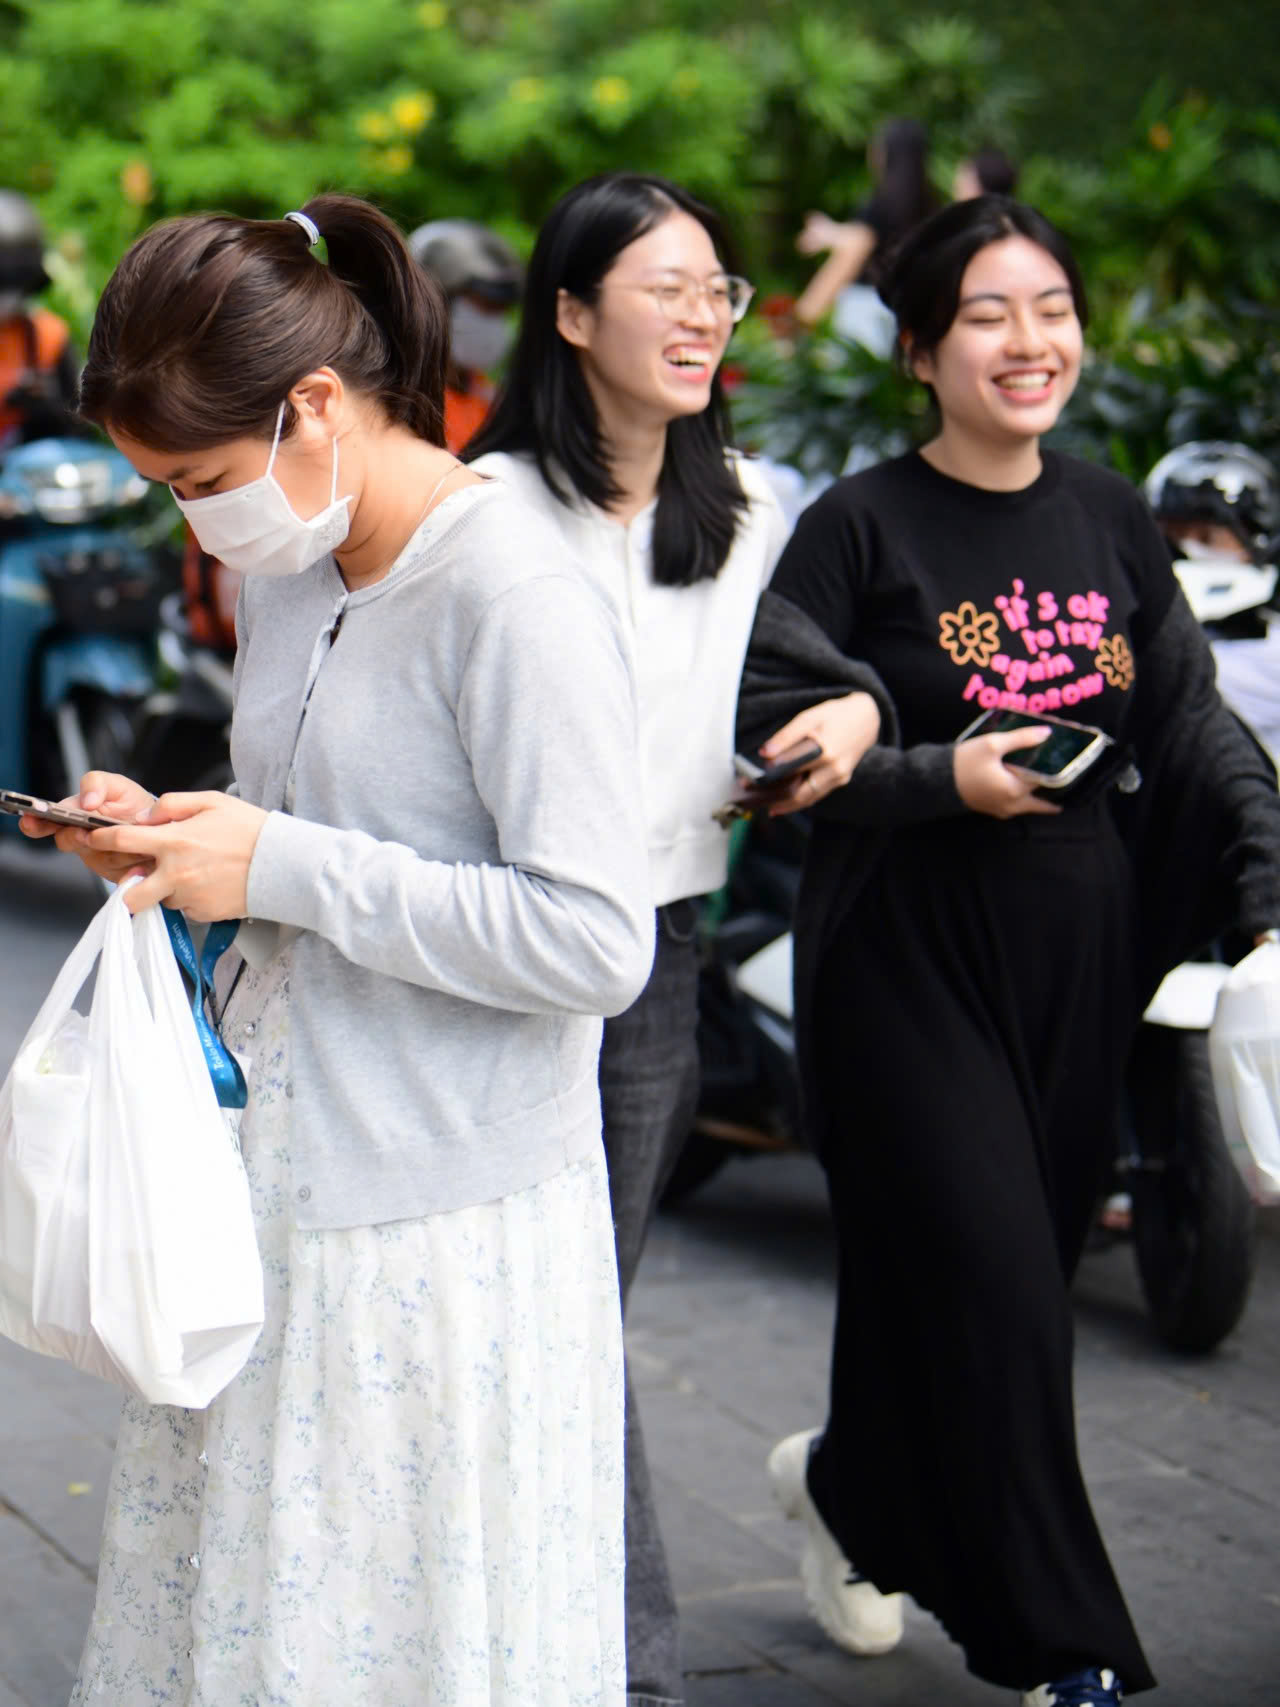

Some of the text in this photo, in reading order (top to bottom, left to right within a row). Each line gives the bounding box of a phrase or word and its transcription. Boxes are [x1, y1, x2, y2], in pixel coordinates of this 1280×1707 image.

[1067, 590, 1110, 624] ok
[1021, 628, 1055, 655] to
[989, 651, 1075, 693] again
[172, 922, 193, 963] Vietnam
